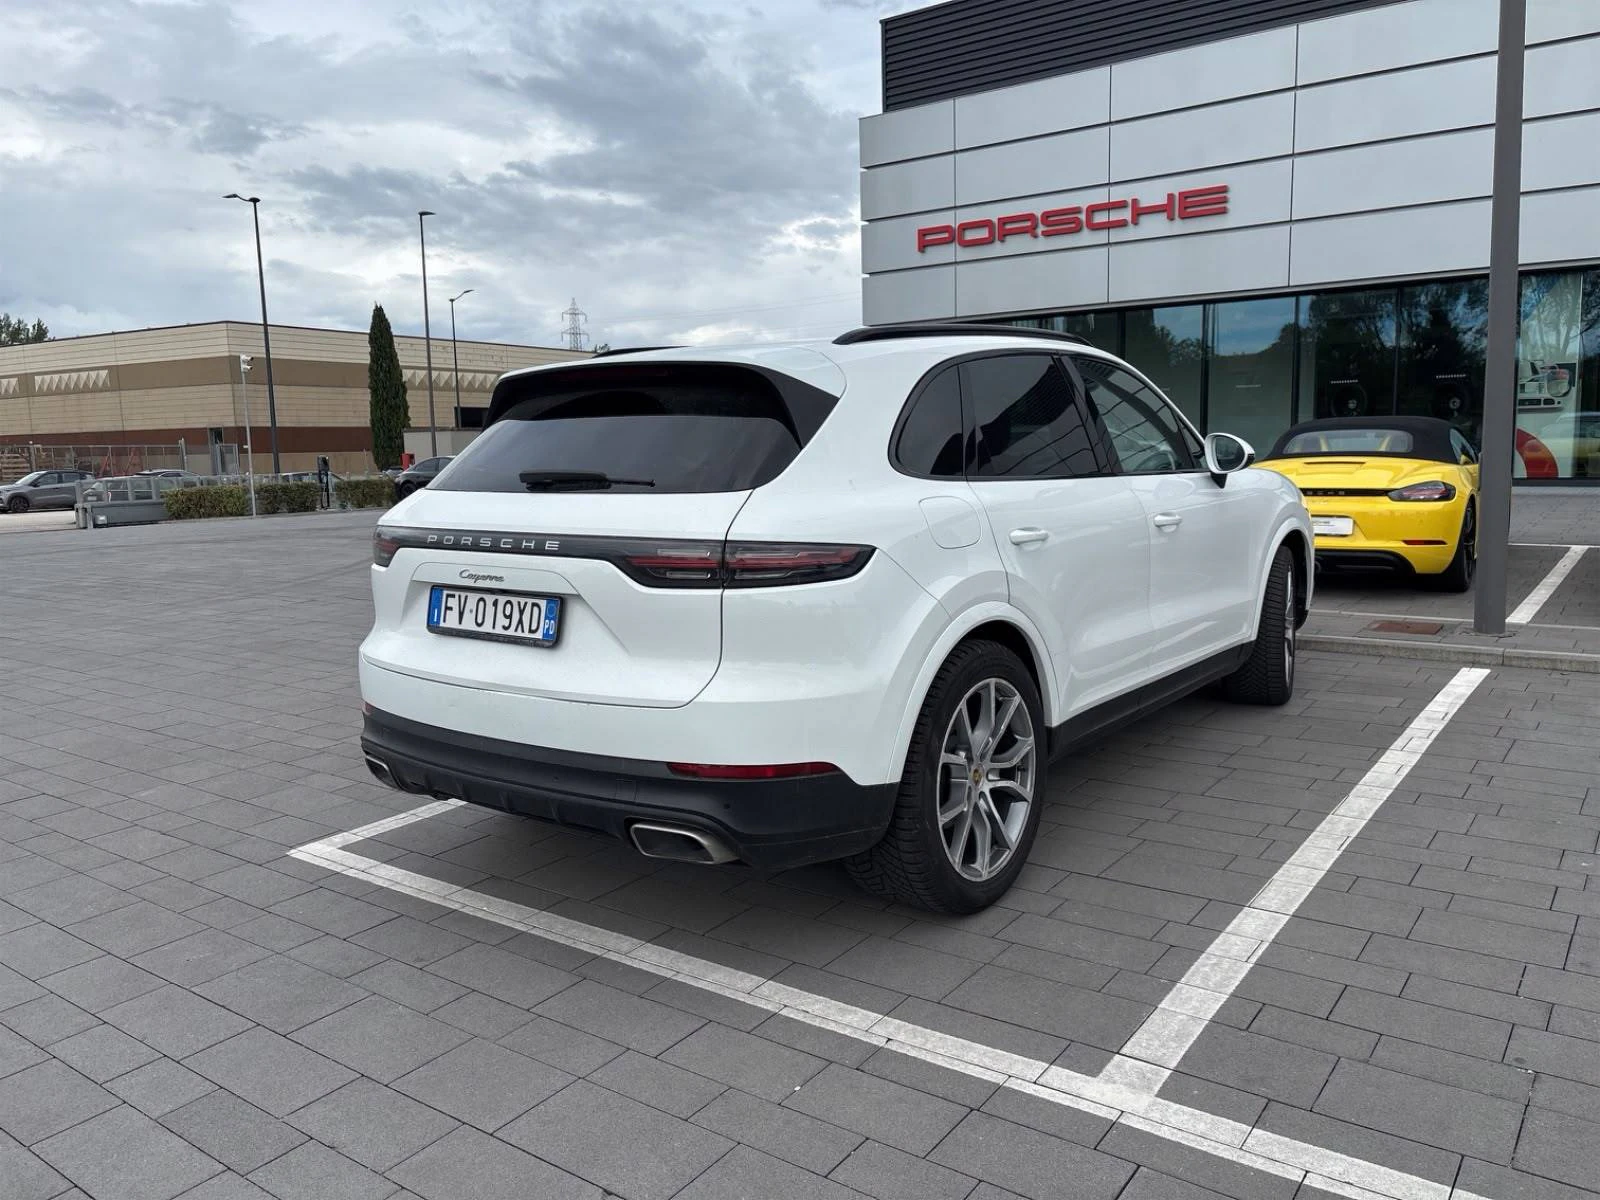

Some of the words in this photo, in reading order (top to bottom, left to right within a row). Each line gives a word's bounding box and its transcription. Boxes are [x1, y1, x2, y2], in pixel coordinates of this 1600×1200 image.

[916, 184, 1229, 253] PORSCHE
[426, 534, 561, 550] PORSCHE
[458, 569, 504, 583] Cayenne
[543, 620, 555, 635] PD
